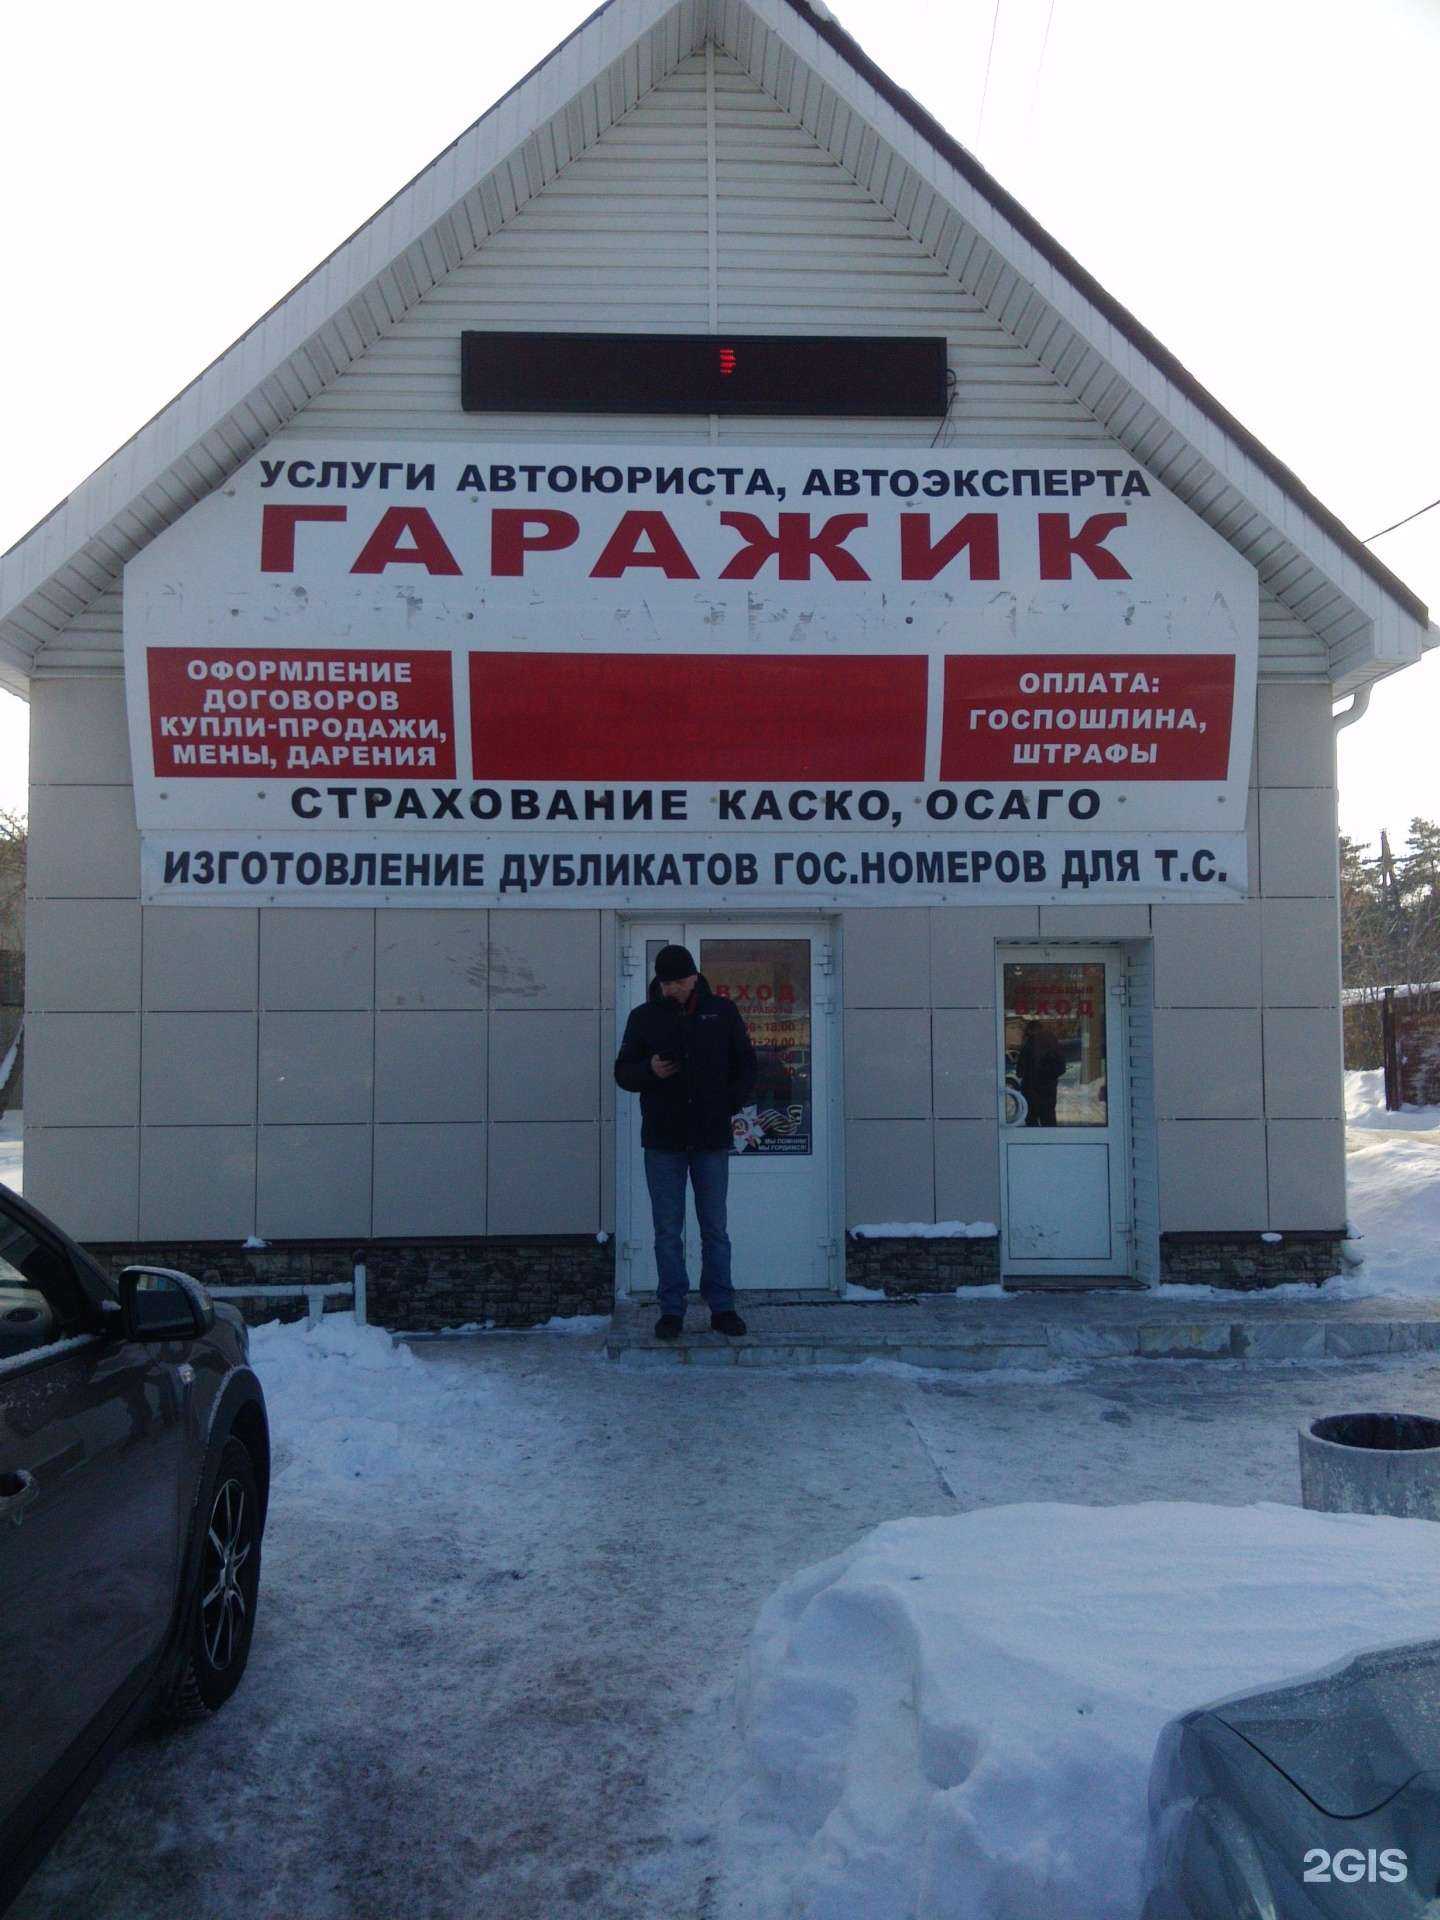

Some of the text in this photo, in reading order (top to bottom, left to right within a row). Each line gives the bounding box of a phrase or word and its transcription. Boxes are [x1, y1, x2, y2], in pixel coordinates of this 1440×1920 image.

[260, 461, 1151, 502] УСЛУГИ АВТОЮРИСТА, АВТОЭКСПЕРТА
[260, 504, 1133, 581] ГАРАЖИК
[187, 660, 412, 683] ОФОРМЛЕНИЕ
[1019, 672, 1160, 694] ОПЛАТА:
[203, 689, 399, 712] ДОГОВОРОВ
[160, 717, 447, 743] КУПЛИ-ПРОДАЖИ,
[969, 709, 1207, 734] ГОСПОШЛИНА,
[173, 745, 436, 769] МЕНЫ, ДАРЕНИЯ
[1013, 743, 1158, 764] ШТРАФЫ
[292, 787, 1101, 828] СТРАХОВАНИЕ КАСКО, ОСАГО
[163, 849, 1228, 894] ИЗГОТОВЛЕНИЕ ДУБЛИКАТОВ ГОС.НОМЕРОВ ДЛЯ Т.С.
